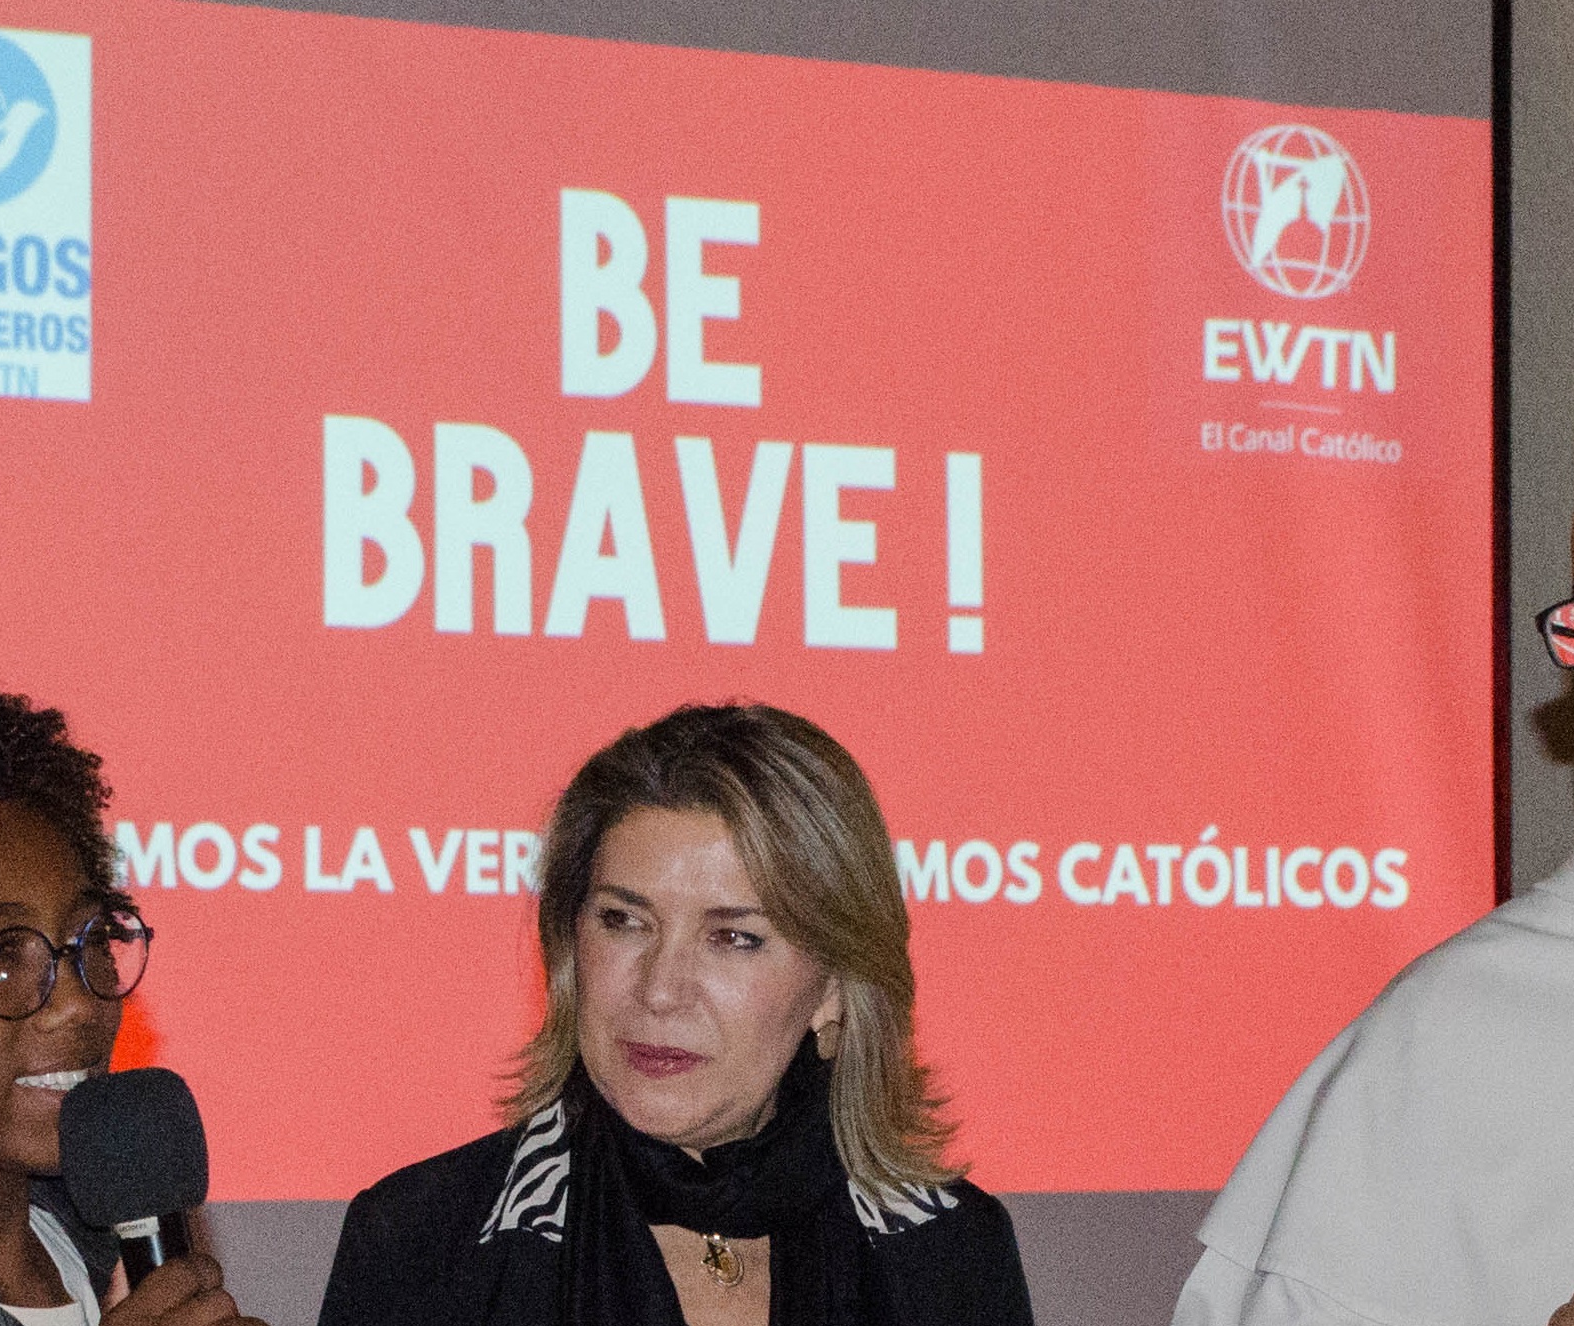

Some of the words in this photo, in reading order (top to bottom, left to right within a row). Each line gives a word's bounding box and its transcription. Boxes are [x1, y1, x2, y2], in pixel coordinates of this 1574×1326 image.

[560, 187, 762, 408] BE
[1203, 318, 1396, 393] EWTN
[1200, 421, 1223, 451] El
[1229, 422, 1295, 453] Canal
[1300, 426, 1403, 463] Católico
[323, 413, 898, 650] BRAVE
[945, 452, 984, 654] !
[110, 820, 283, 891] MOS
[304, 825, 395, 893] LA
[408, 827, 542, 896] VER
[894, 838, 1043, 904] MOS
[1057, 824, 1410, 908] CATÓLICOS
